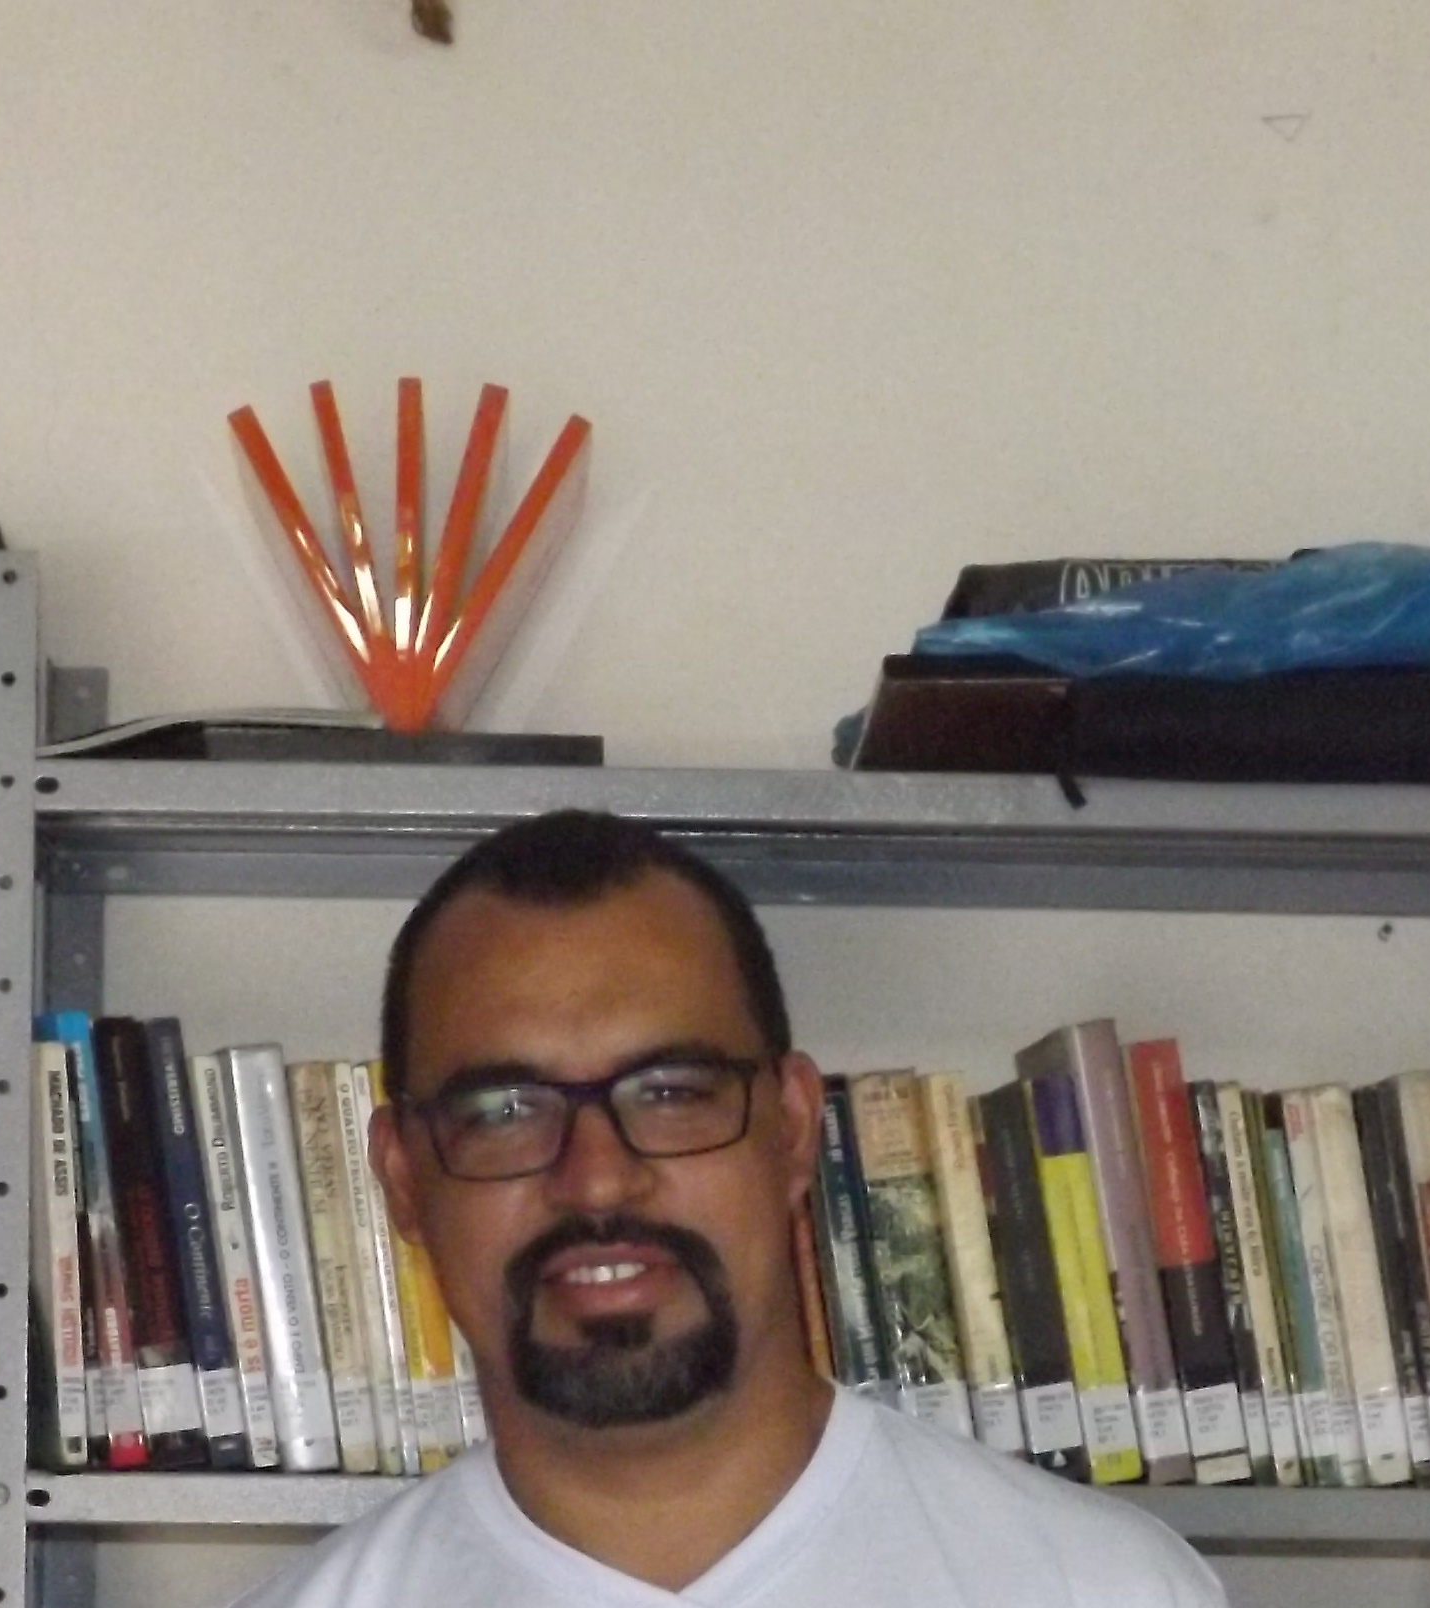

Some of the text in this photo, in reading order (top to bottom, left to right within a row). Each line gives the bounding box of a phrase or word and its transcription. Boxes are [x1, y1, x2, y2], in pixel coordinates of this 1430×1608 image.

[339, 1096, 358, 1157] QUARTO
[347, 1158, 367, 1227] FECHADO
[184, 1200, 219, 1318] O Continente
[230, 1275, 255, 1334] morta
[282, 1272, 298, 1312] VENTO
